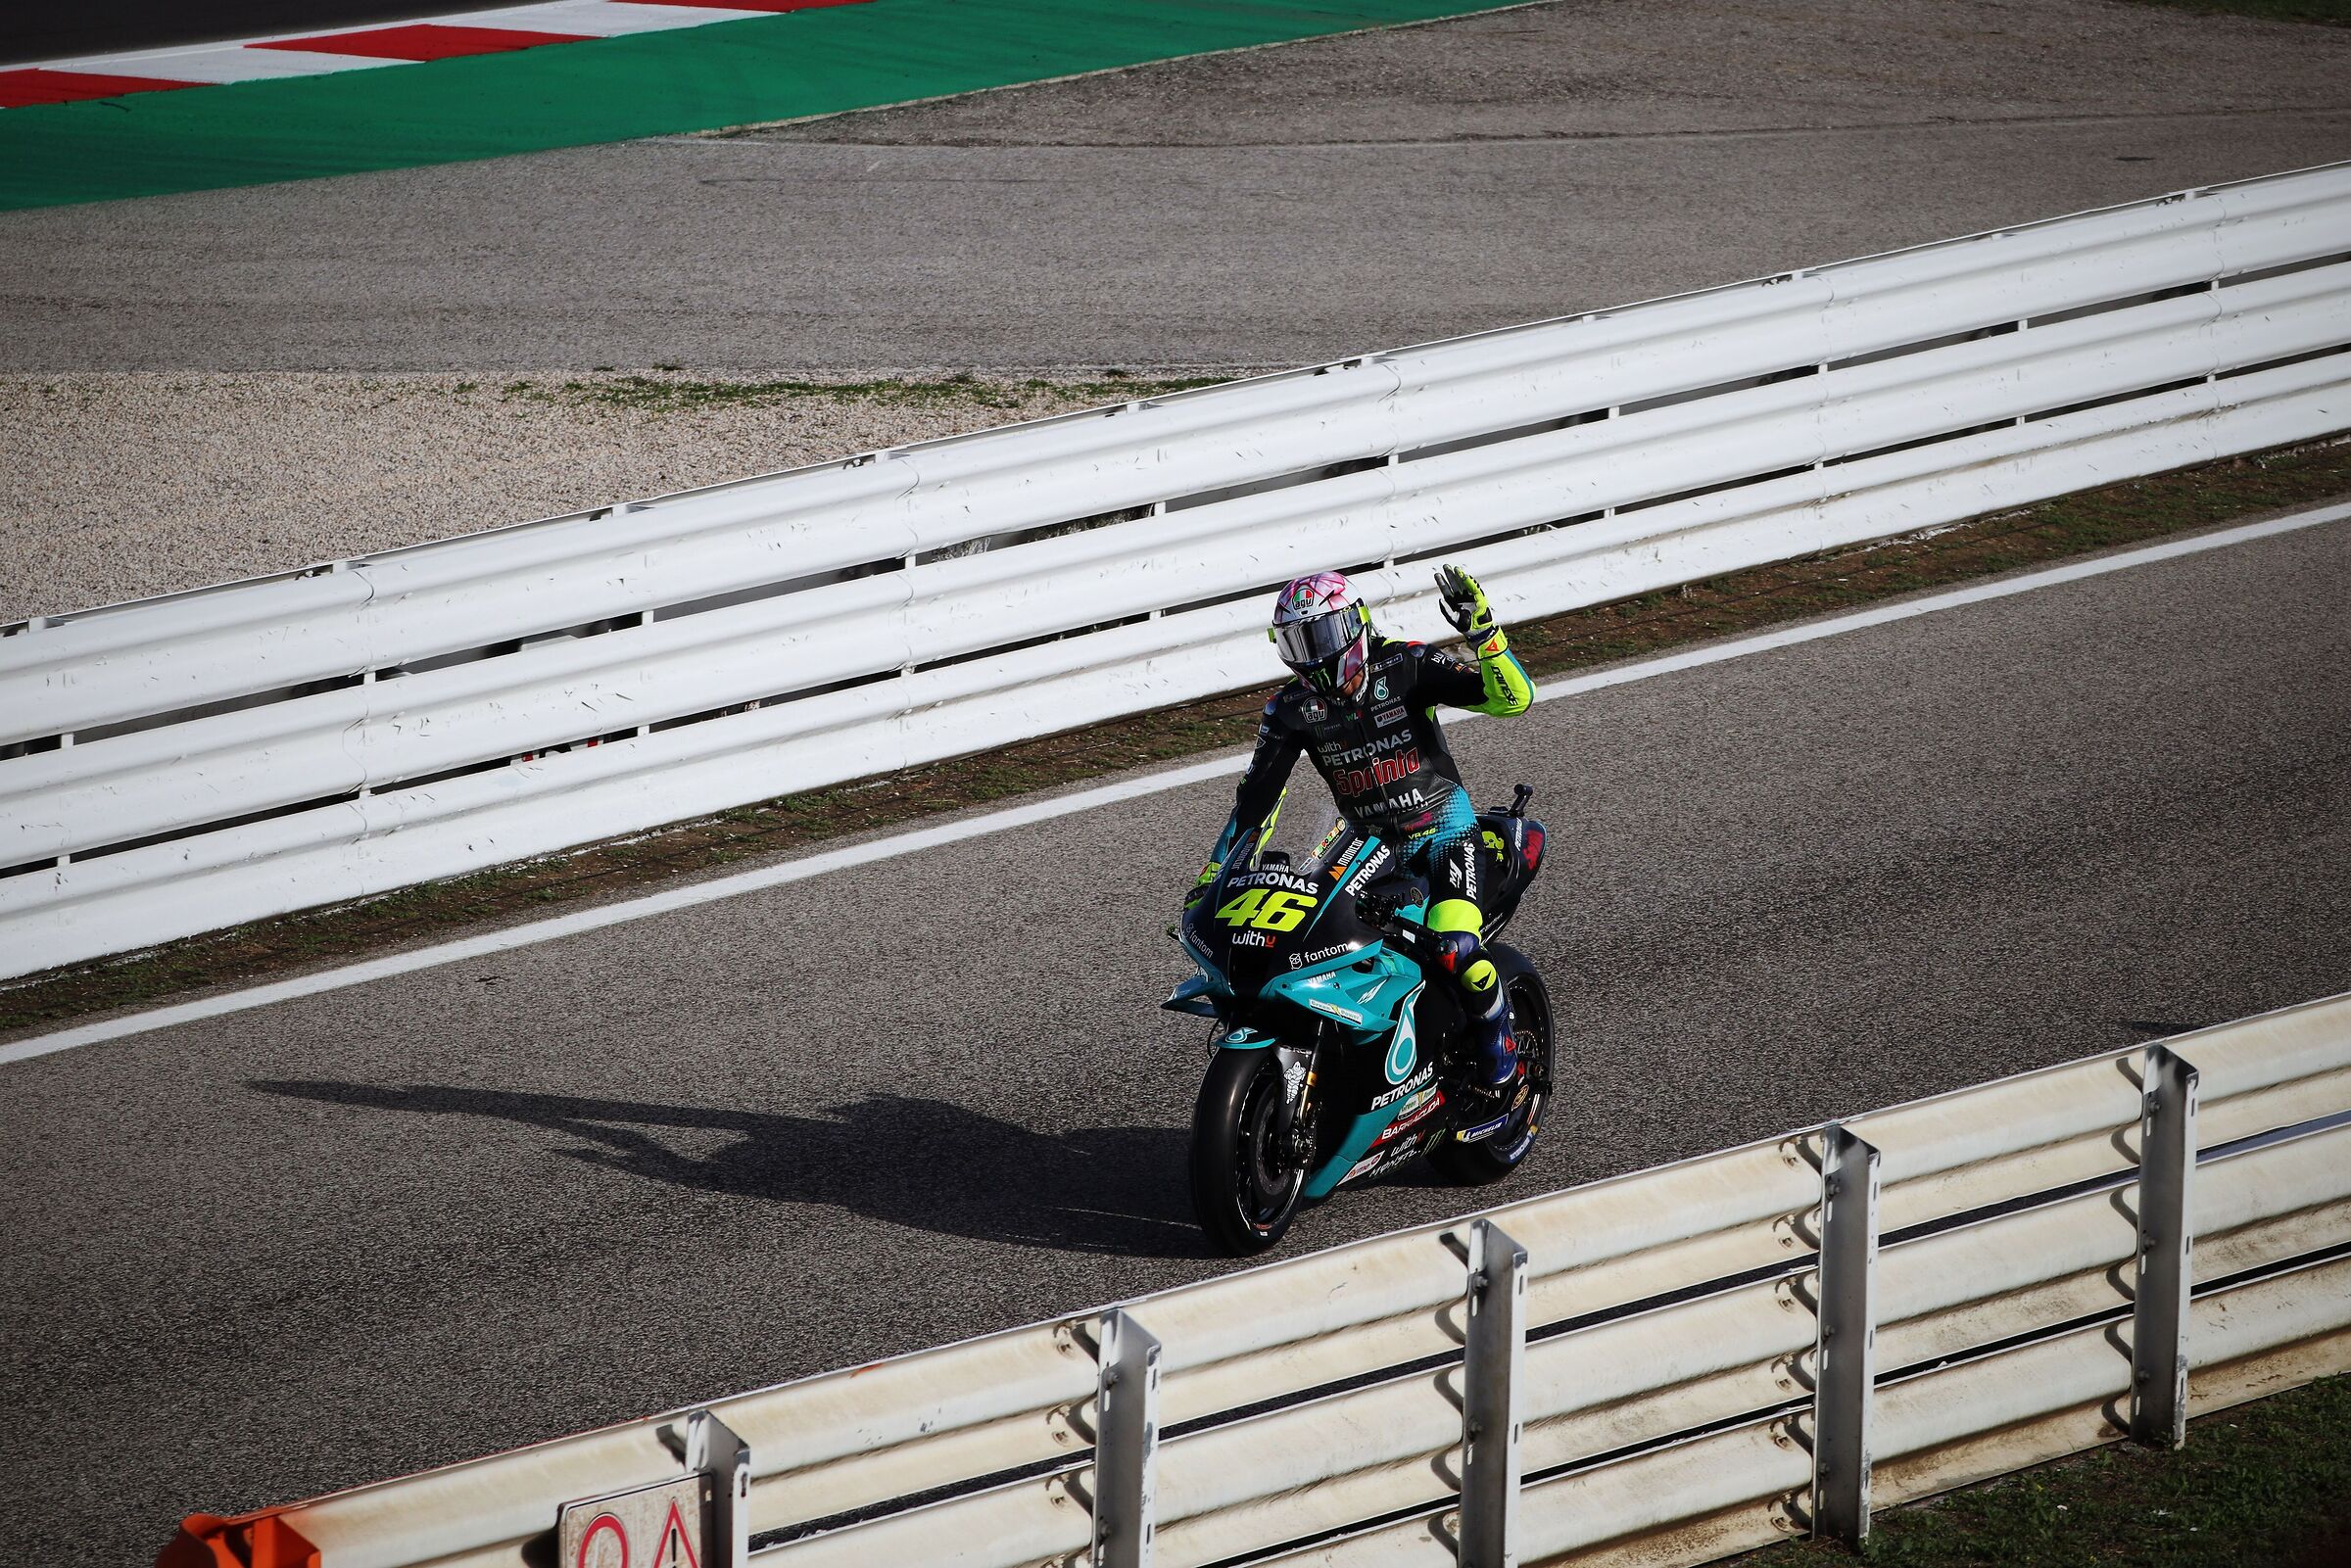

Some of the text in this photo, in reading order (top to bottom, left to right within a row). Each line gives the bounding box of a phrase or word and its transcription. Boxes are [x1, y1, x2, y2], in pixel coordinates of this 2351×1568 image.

[1370, 695, 1402, 712] PETRONAS
[1321, 729, 1413, 766] PETRONAS
[1333, 747, 1420, 798] Sprinta
[1354, 787, 1425, 819] YAMAHA
[1226, 872, 1319, 895] PETRONAS
[1262, 863, 1289, 874] YAMAHA
[1344, 844, 1391, 897] PETRONAS
[1214, 888, 1319, 932] 46
[1188, 930, 1214, 960] fantom
[1304, 942, 1349, 964] fantom
[1370, 1061, 1434, 1112] PETRONAS
